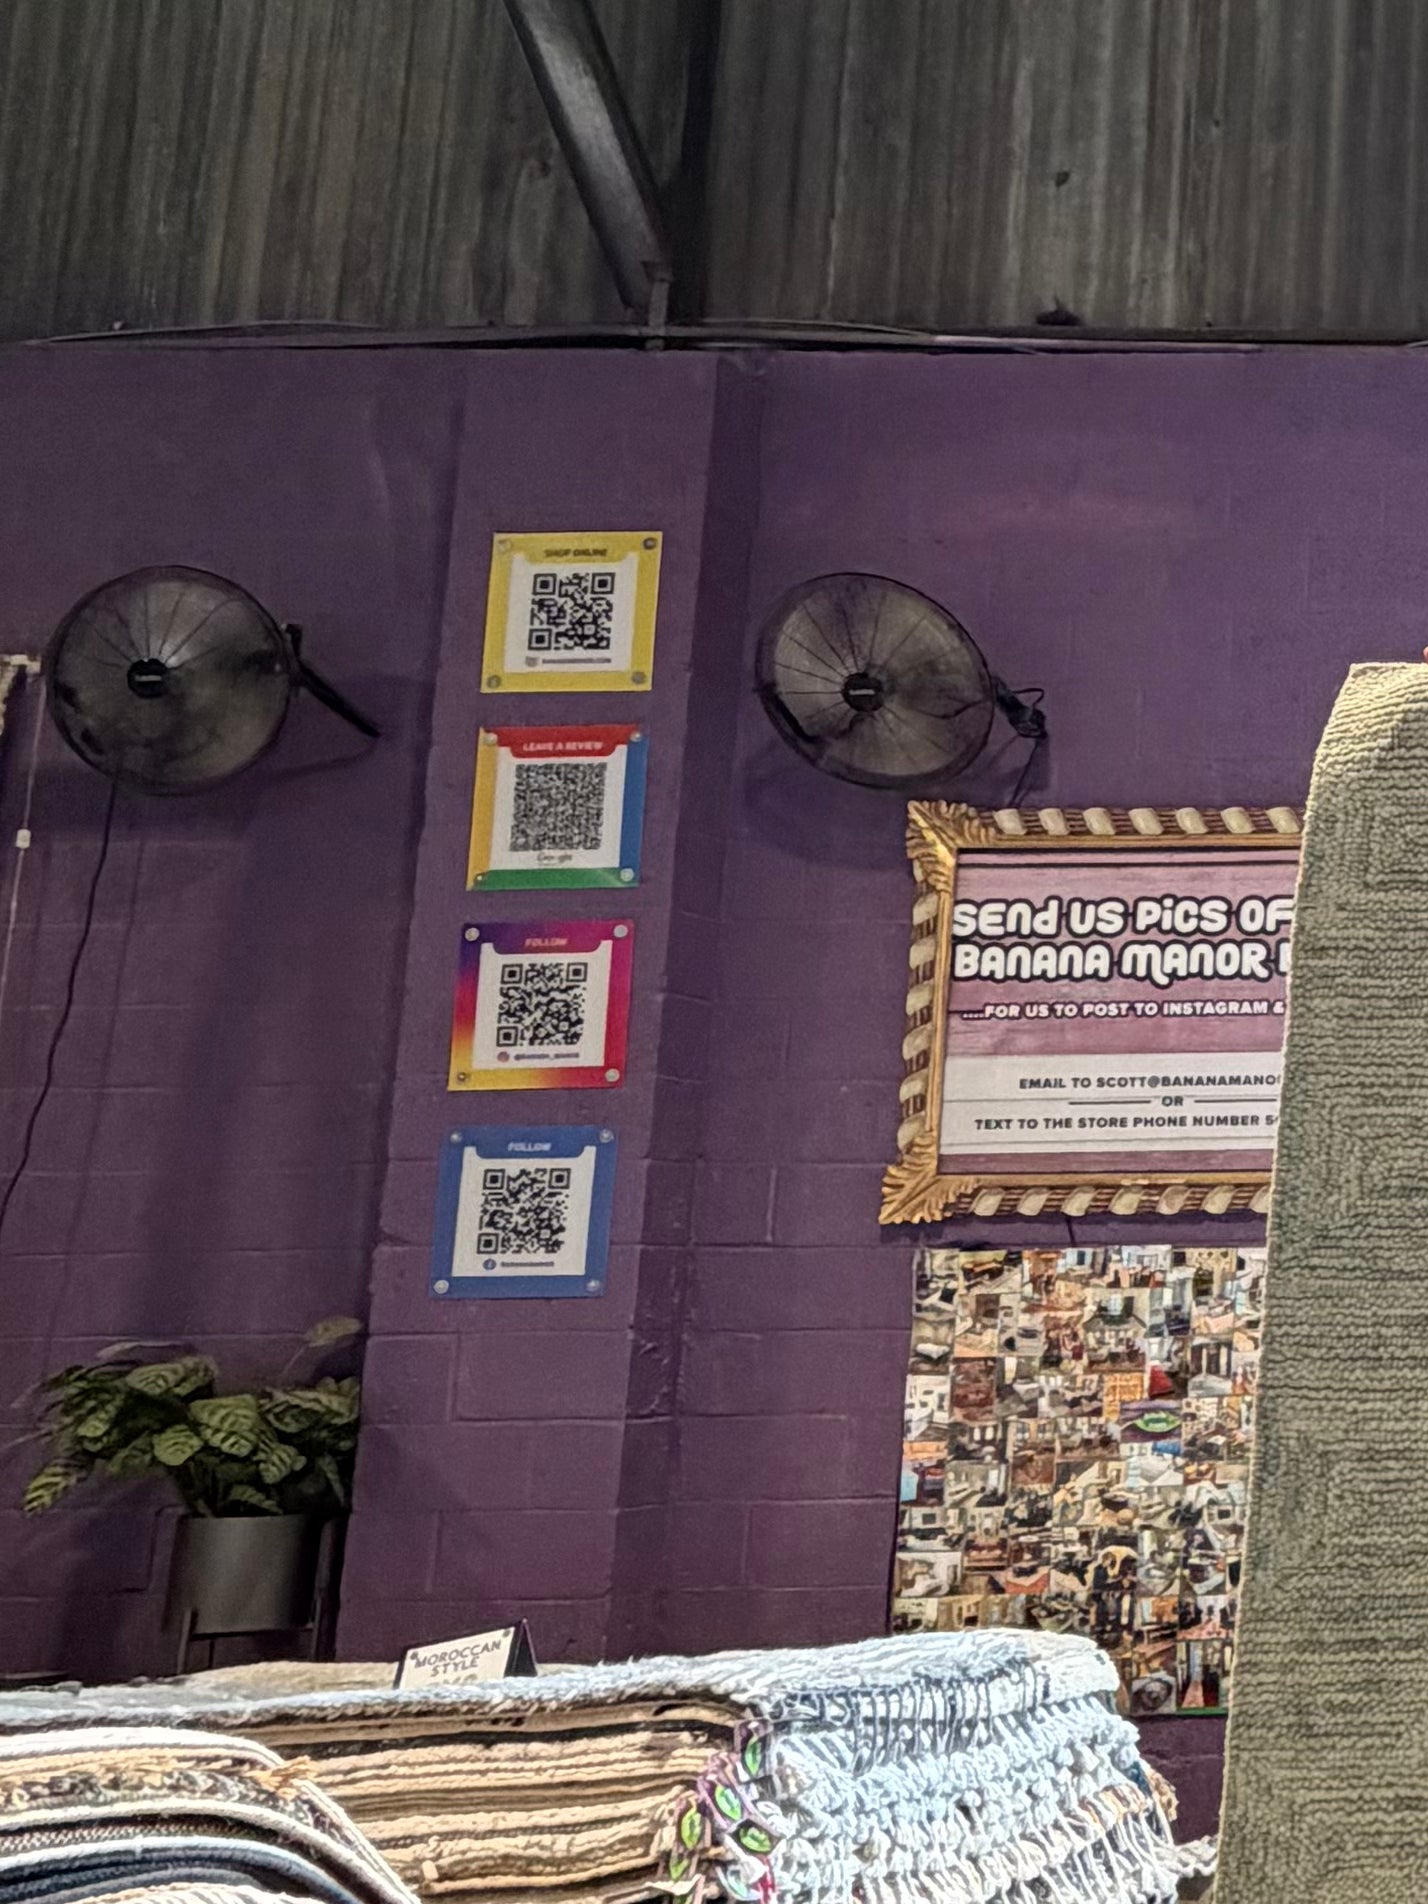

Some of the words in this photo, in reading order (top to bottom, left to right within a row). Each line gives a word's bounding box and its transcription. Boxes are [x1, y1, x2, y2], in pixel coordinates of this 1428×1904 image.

[523, 742, 553, 752] LEAVE
[565, 741, 603, 751] REVIEW
[1069, 900, 1126, 936] US
[524, 938, 568, 947] FOLLOW
[1025, 1003, 1049, 1018] US
[1054, 1003, 1078, 1018] TO
[1083, 1002, 1129, 1017] POST
[1134, 1002, 1159, 1016] TO
[1163, 1000, 1268, 1015] INSTAGRAM
[1272, 1001, 1285, 1014] &
[1019, 1077, 1066, 1090] EMAIL
[1071, 1077, 1092, 1089] TO
[1161, 1096, 1184, 1107] OR
[974, 1119, 1013, 1130] TEXT
[1018, 1118, 1038, 1130] TO
[1043, 1118, 1073, 1129] THE
[1077, 1117, 1128, 1129] STORE
[1133, 1116, 1187, 1128] PHONE
[1192, 1115, 1260, 1127] NUMBER
[507, 1142, 552, 1152] FOLLOW
[415, 1639, 502, 1669] MOROCCAN
[430, 1656, 480, 1677] STYLE
